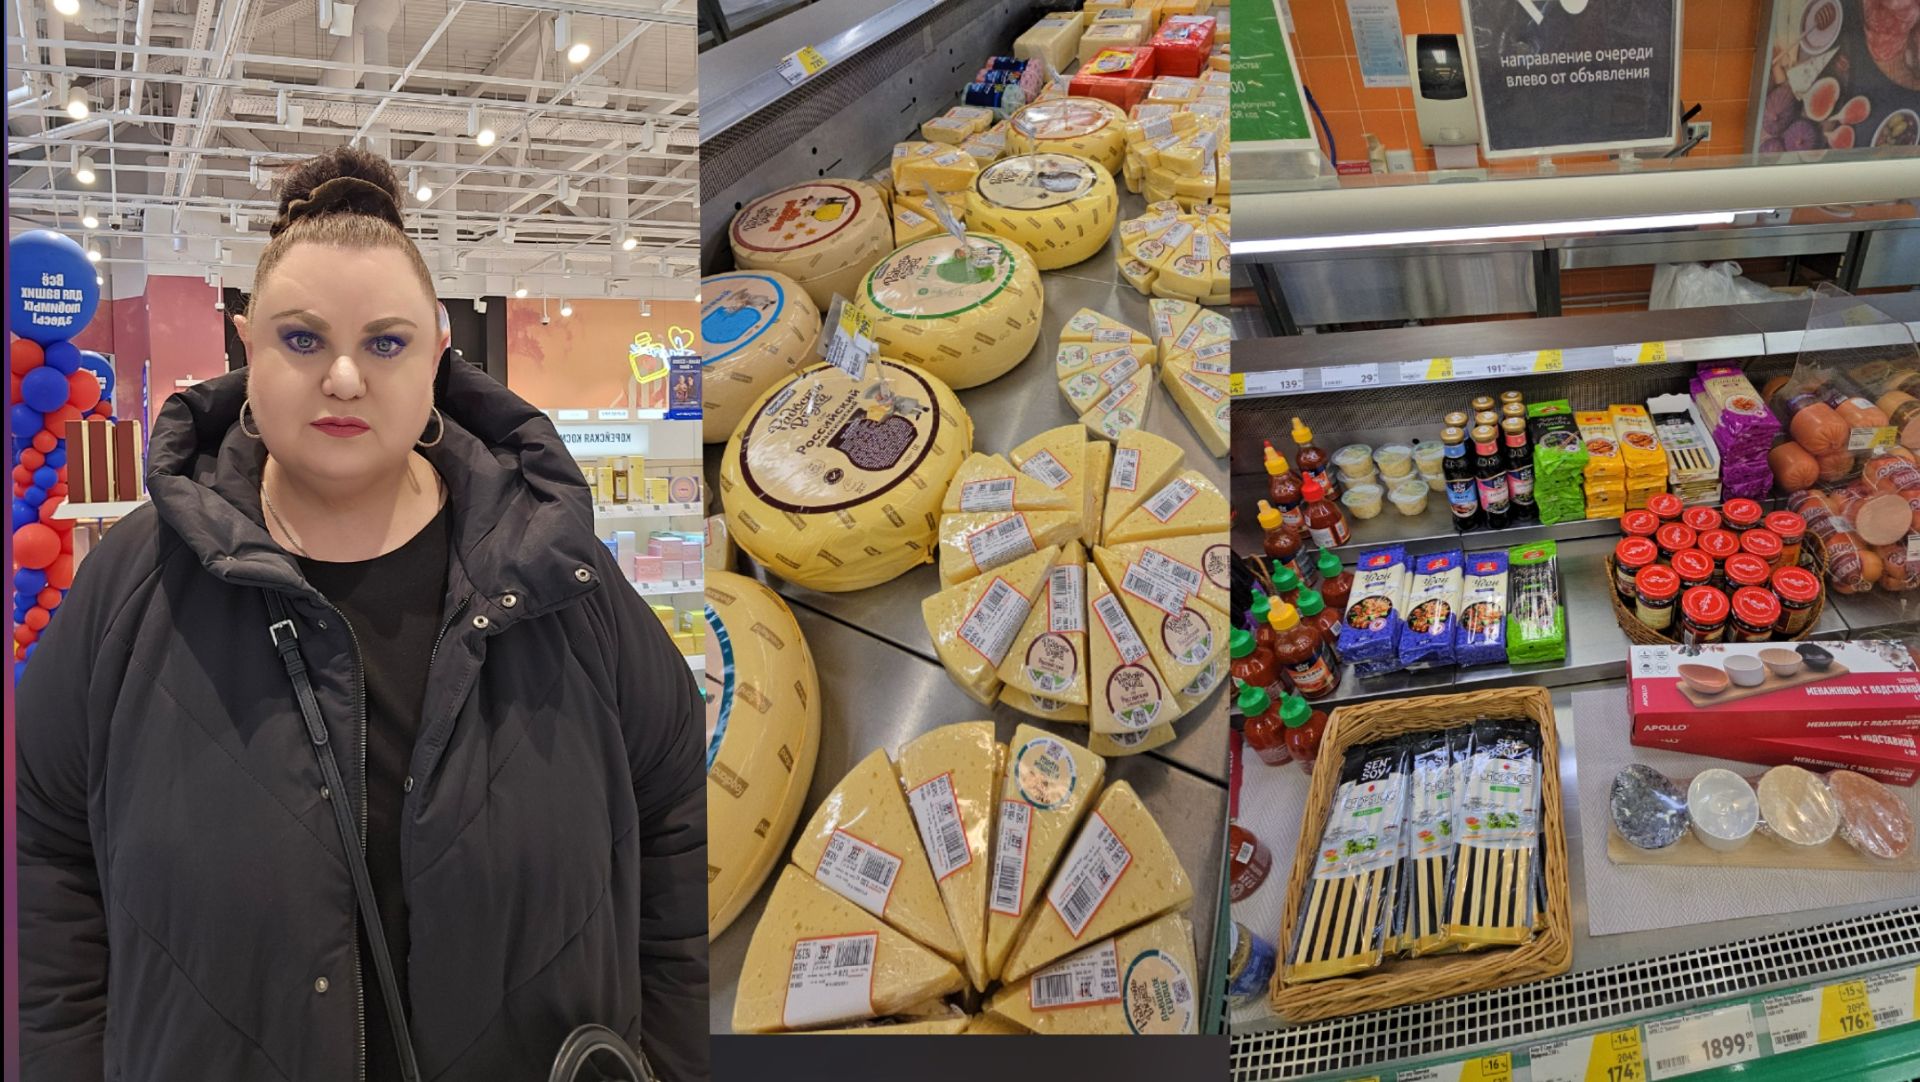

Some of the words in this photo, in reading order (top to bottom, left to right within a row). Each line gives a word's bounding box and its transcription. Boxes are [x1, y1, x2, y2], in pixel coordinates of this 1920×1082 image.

[1501, 50, 1592, 70] направление
[1595, 47, 1654, 64] очереди
[1506, 73, 1547, 88] влево
[1551, 73, 1567, 85] от
[1569, 66, 1650, 83] объявления
[1280, 379, 1298, 389] 139
[1805, 685, 1861, 696] МЕНАЖНИЦЫ
[1862, 686, 1869, 695] С
[1643, 724, 1686, 732] APOLLO
[1806, 720, 1861, 728] МЕНАЖНИЦЫ
[1496, 738, 1520, 748] SEN
[1364, 758, 1389, 772] SEN
[1361, 767, 1386, 781] SOY
[1840, 1014, 1865, 1033] 176
[1702, 1033, 1746, 1062] 1899
[1484, 1059, 1499, 1070] -16
[1607, 1063, 1634, 1082] 174
